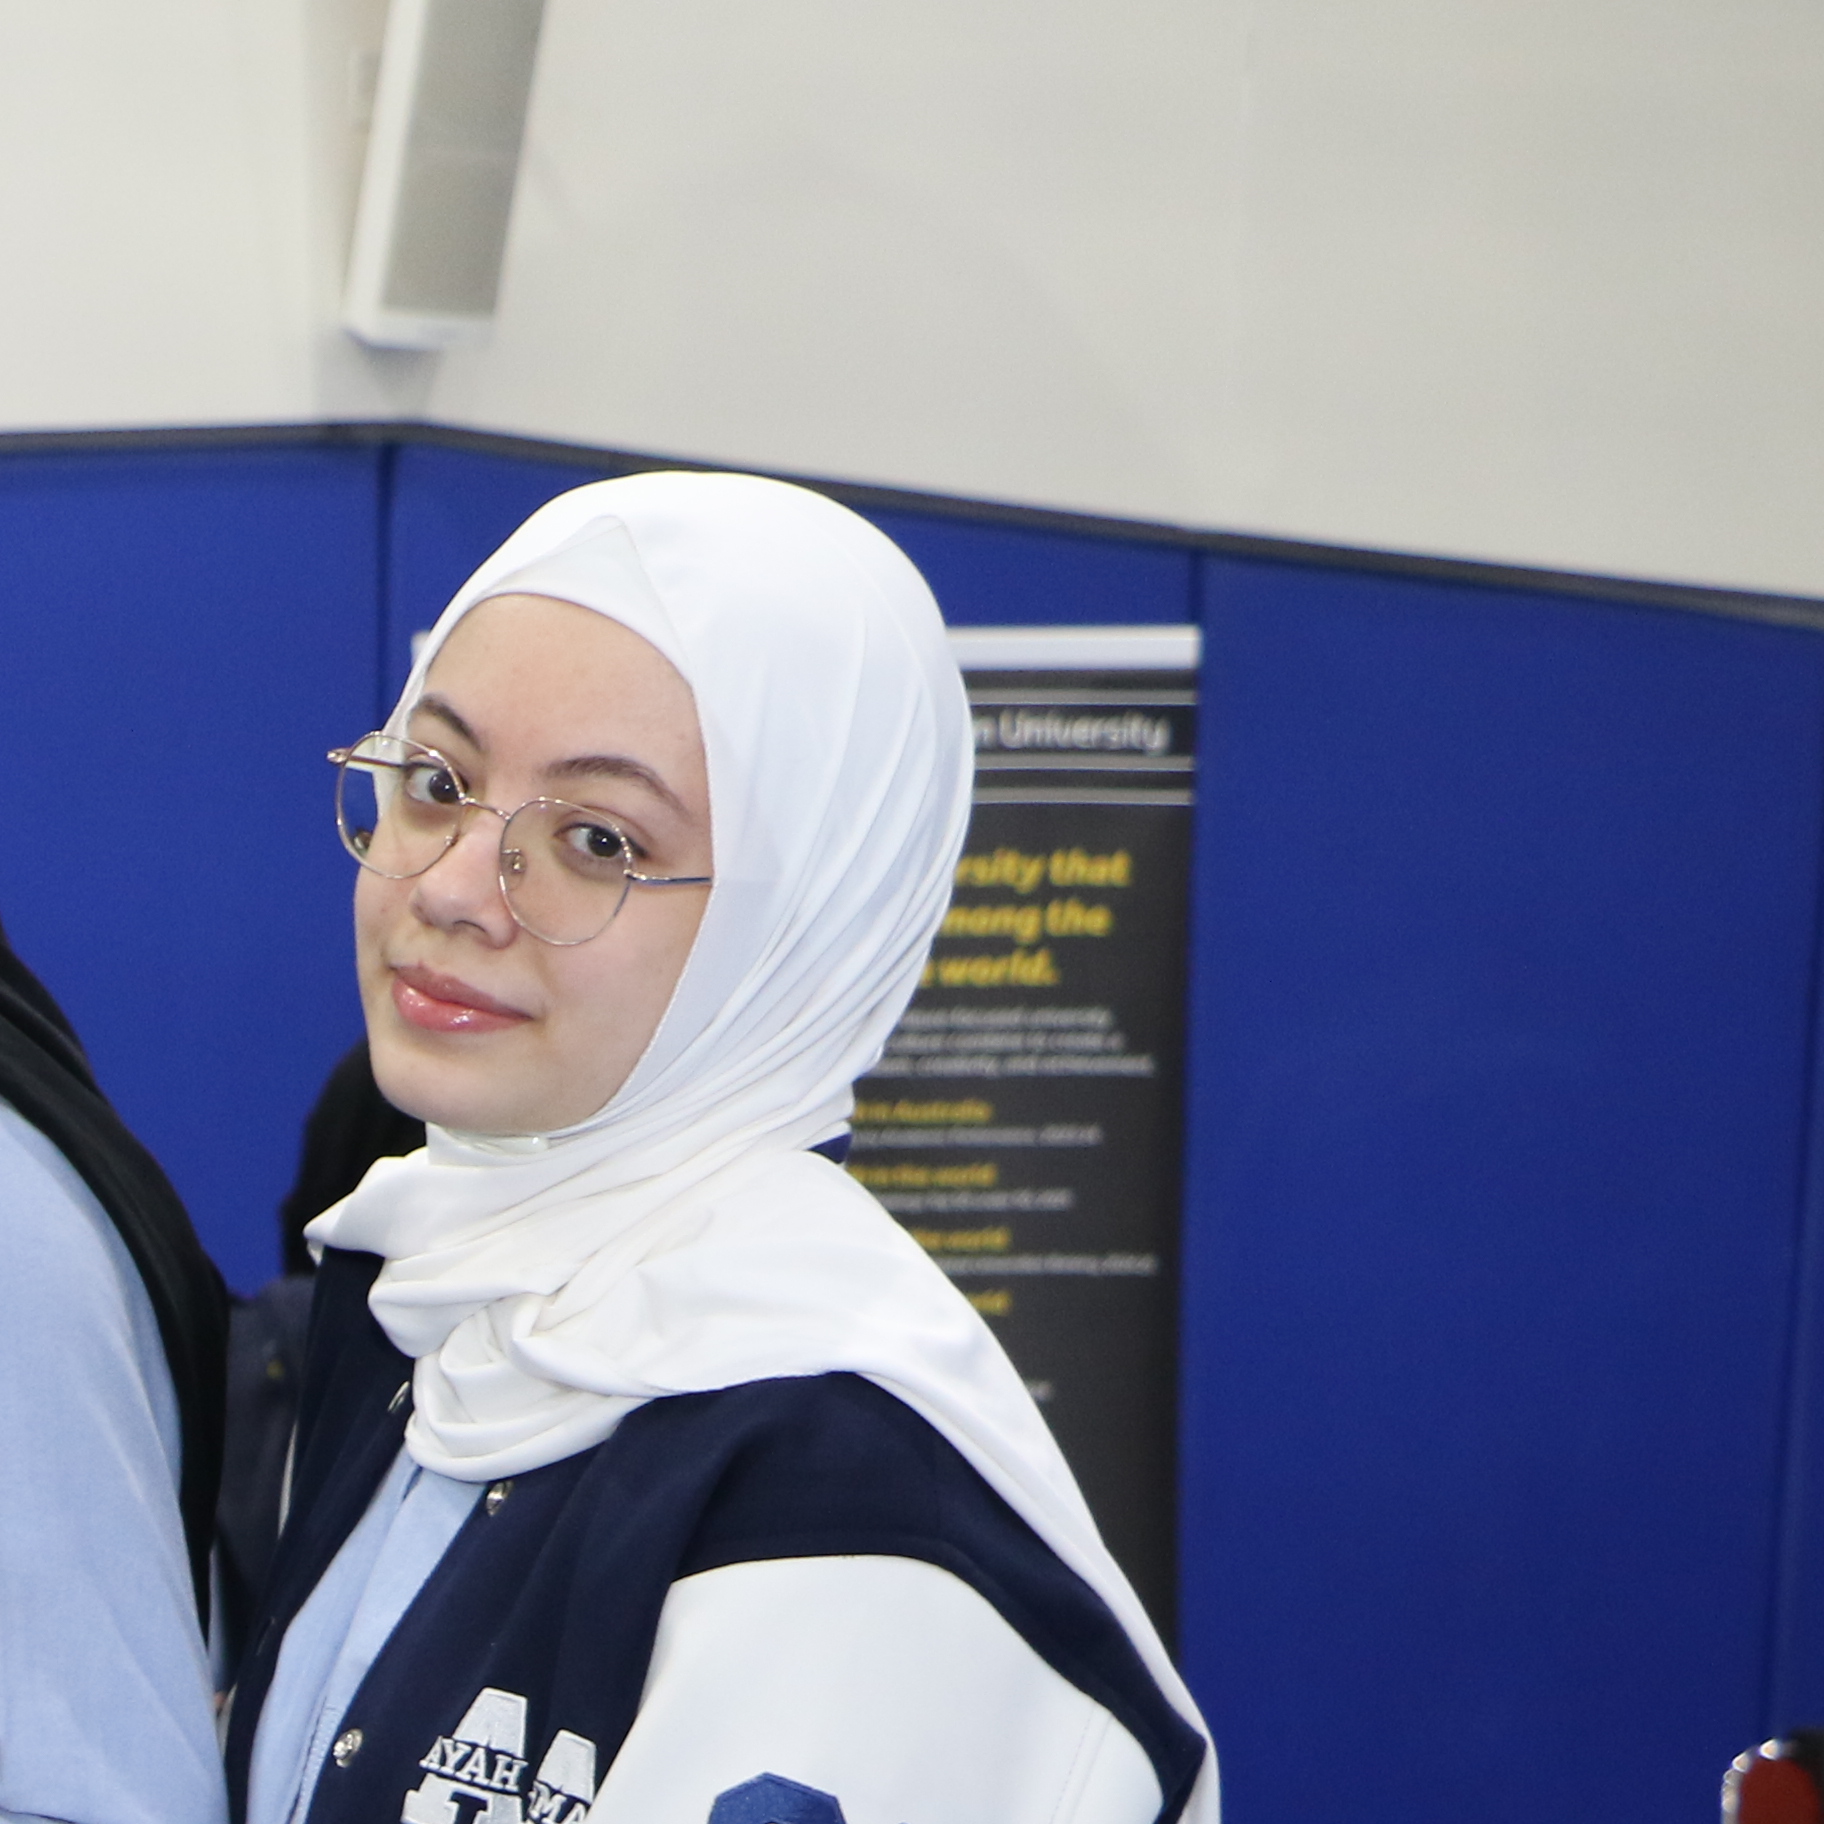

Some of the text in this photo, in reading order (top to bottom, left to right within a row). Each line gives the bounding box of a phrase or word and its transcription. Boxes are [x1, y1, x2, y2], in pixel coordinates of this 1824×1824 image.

[999, 708, 1170, 757] University
[1049, 847, 1132, 887] that
[1046, 897, 1113, 937] the
[938, 947, 1061, 987] world.
[419, 1735, 528, 1793] AYAH
